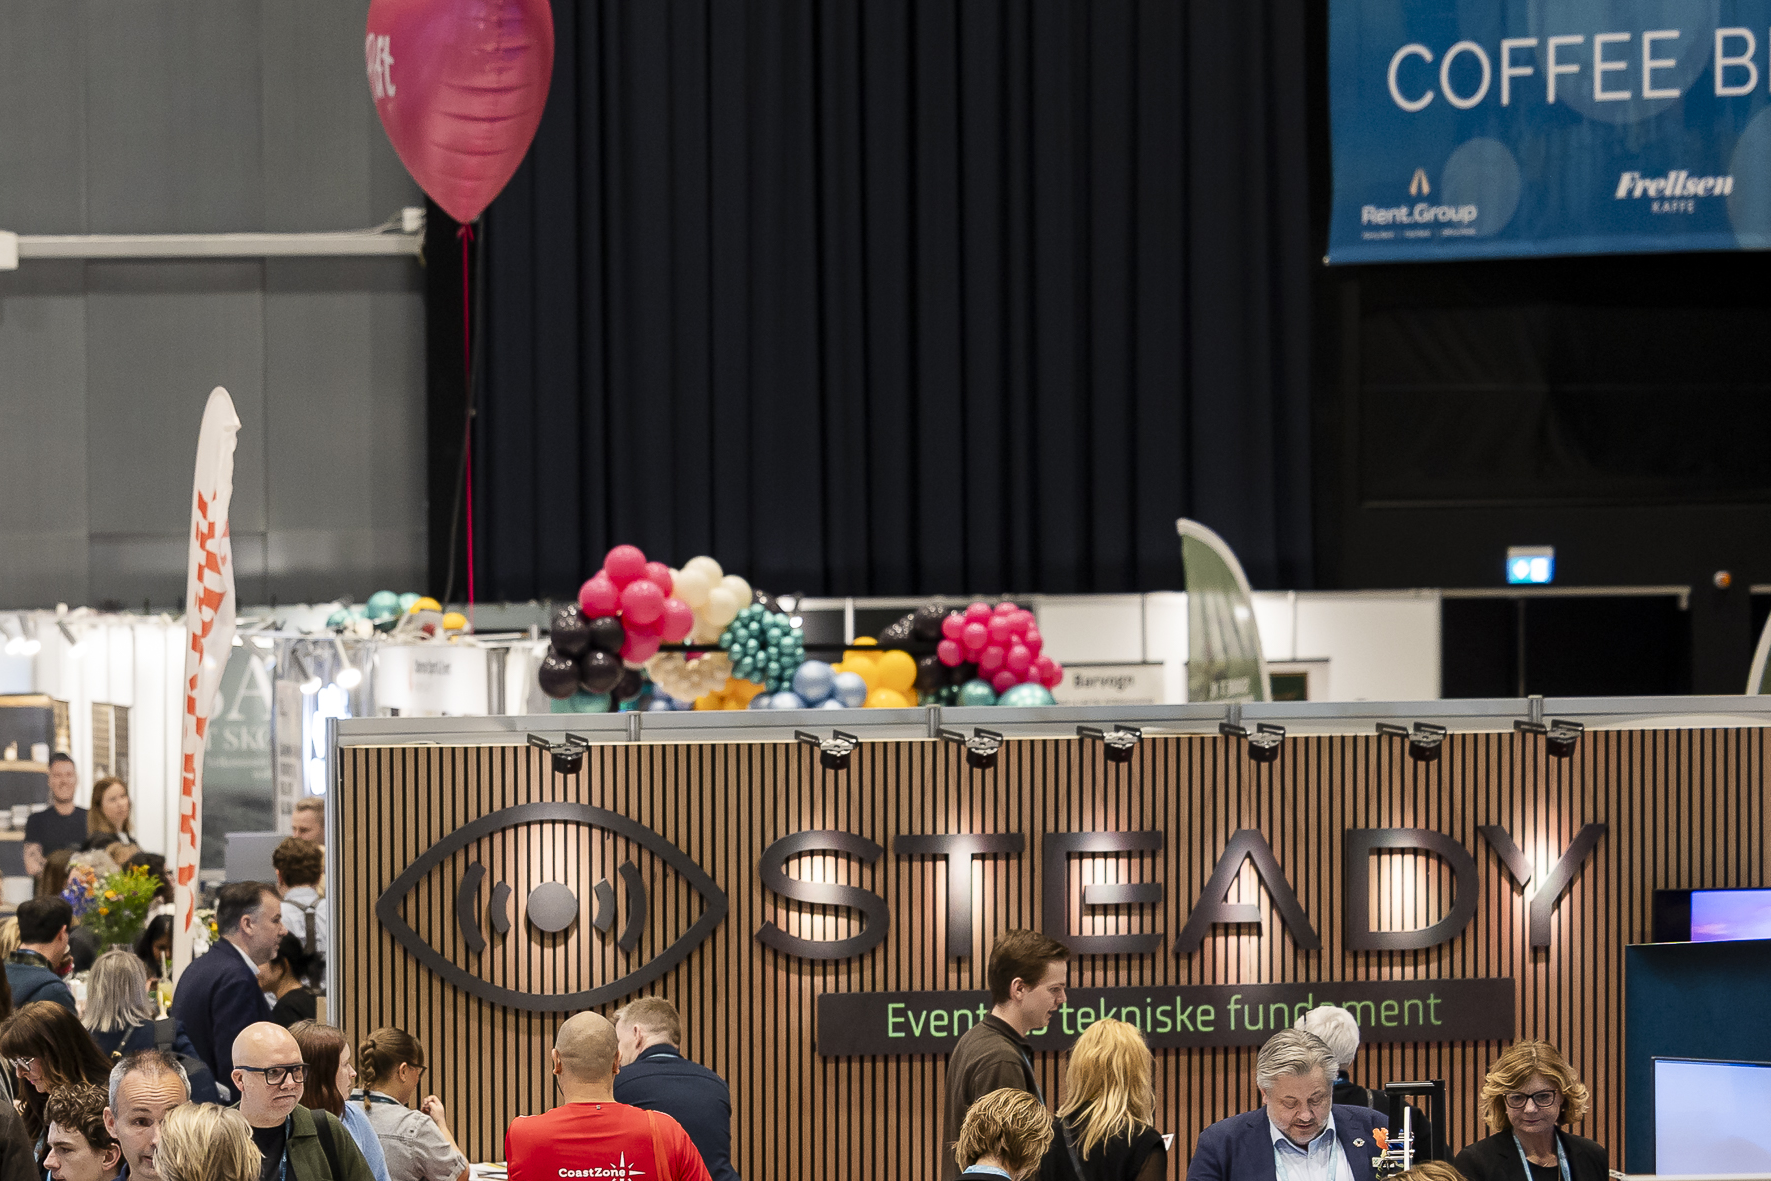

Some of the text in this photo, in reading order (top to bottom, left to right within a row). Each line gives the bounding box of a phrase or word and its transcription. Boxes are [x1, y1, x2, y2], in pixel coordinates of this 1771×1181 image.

[1386, 26, 1771, 113] COFFEE B
[1615, 169, 1735, 200] Frellsen
[754, 822, 1609, 961] STEADY
[1058, 995, 1216, 1035] tekniske
[1227, 992, 1443, 1031] fundment
[558, 1166, 626, 1178] CoastZone
